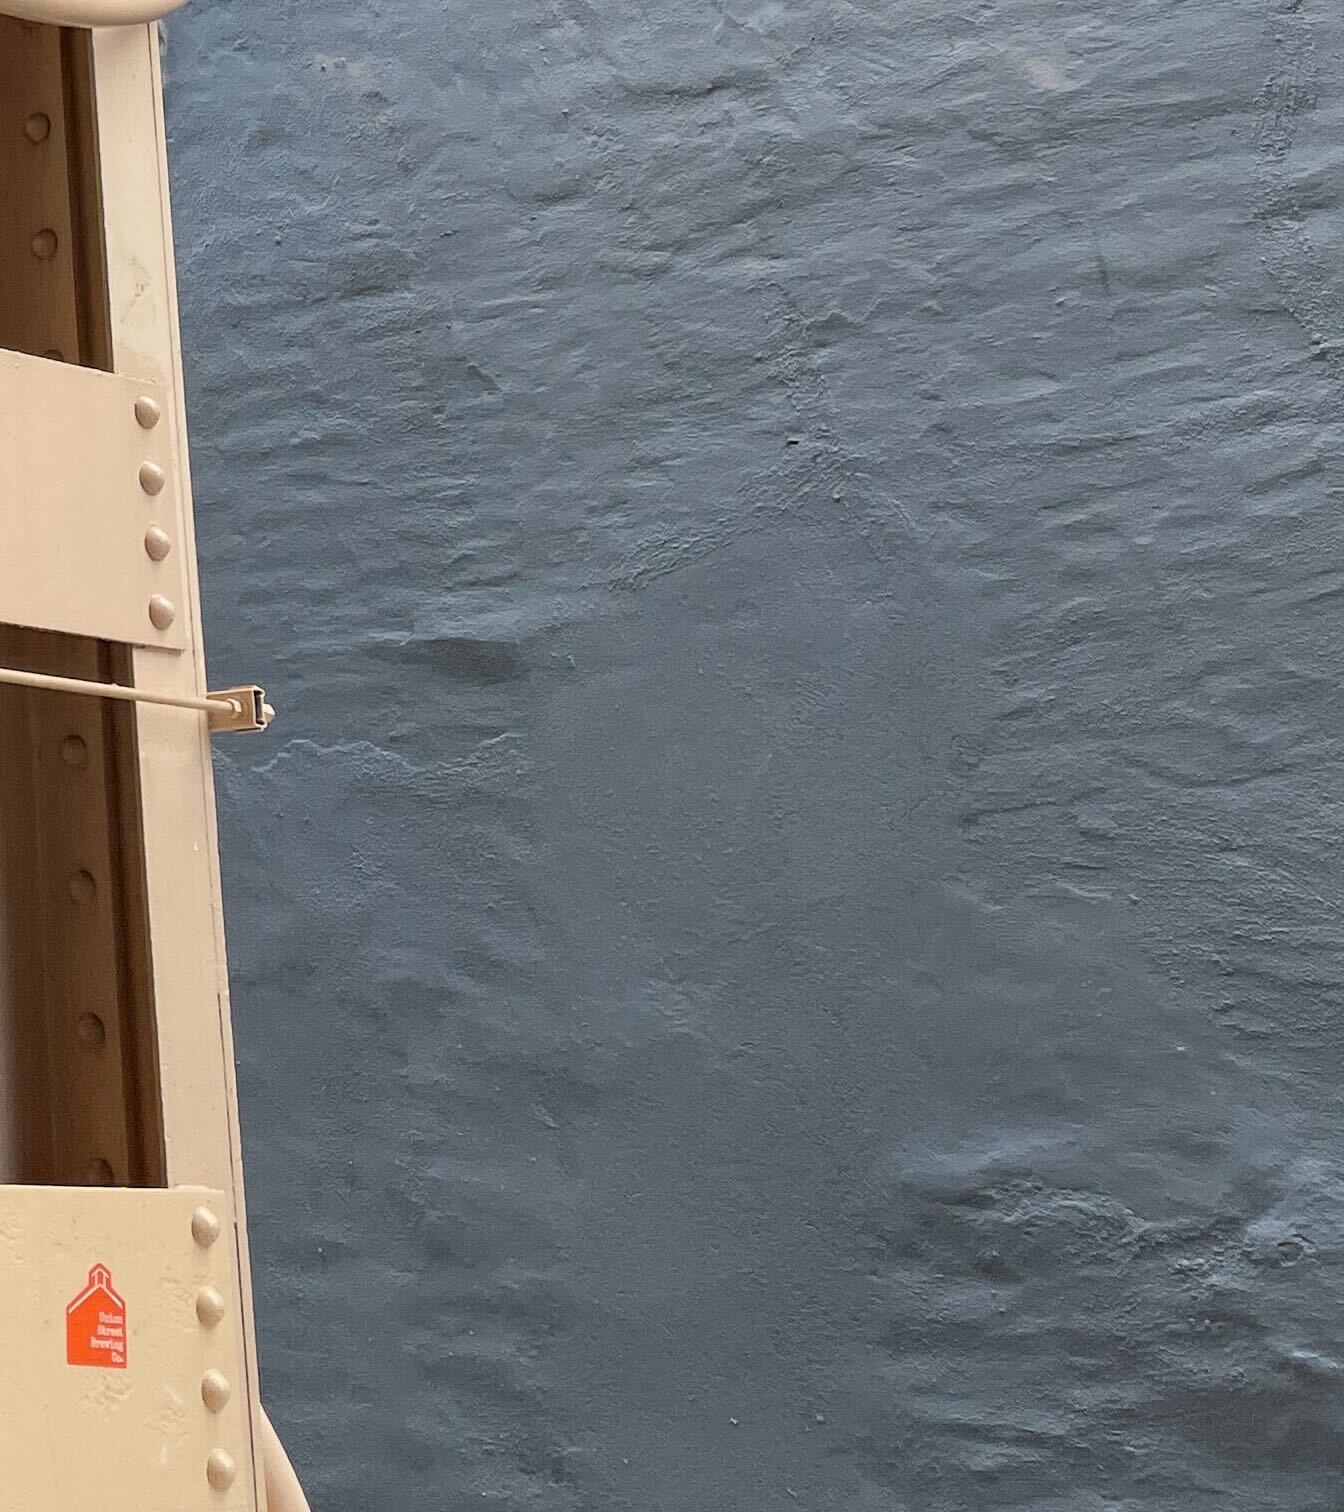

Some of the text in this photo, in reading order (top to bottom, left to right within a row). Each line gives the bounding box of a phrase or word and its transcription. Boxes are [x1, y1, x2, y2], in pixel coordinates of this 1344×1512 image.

[98, 1311, 123, 1324] Union
[97, 1324, 124, 1337] Street
[90, 1336, 124, 1353] Brewing
